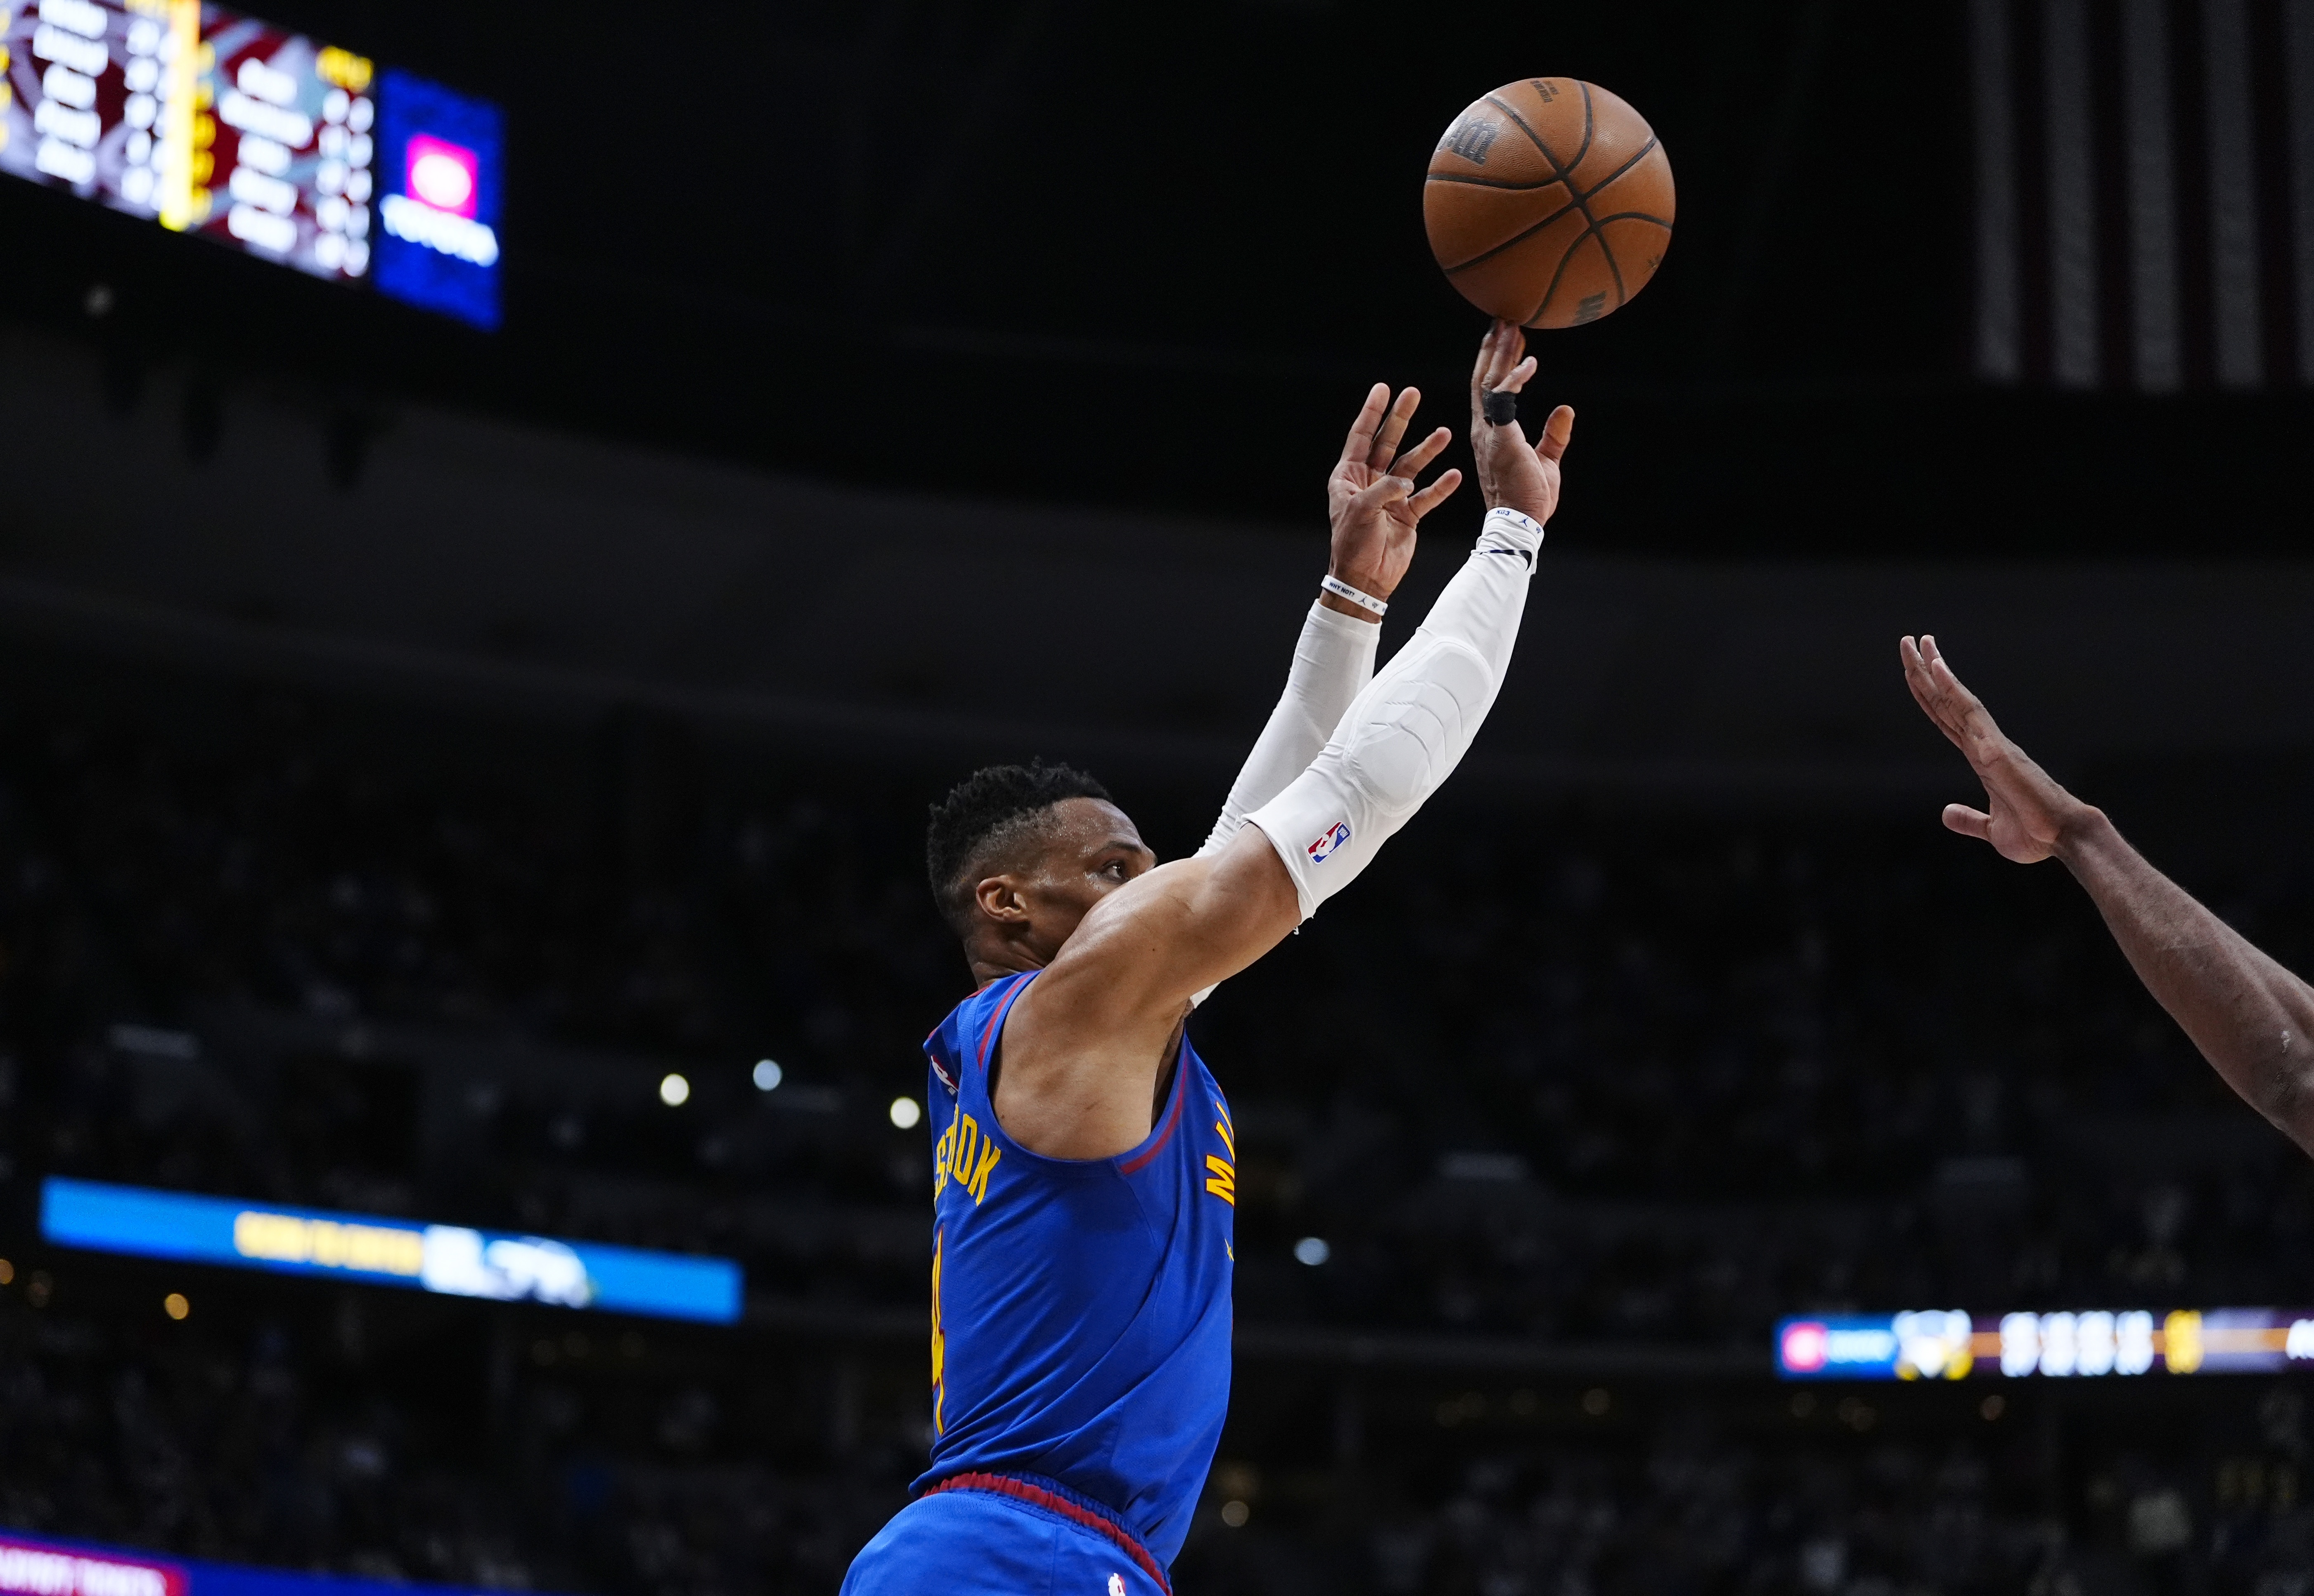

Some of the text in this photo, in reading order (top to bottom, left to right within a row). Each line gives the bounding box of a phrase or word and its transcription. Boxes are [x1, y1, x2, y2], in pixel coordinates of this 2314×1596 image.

[1329, 581, 1355, 597] WHY NOT?
[1338, 827, 1349, 838] NBA
